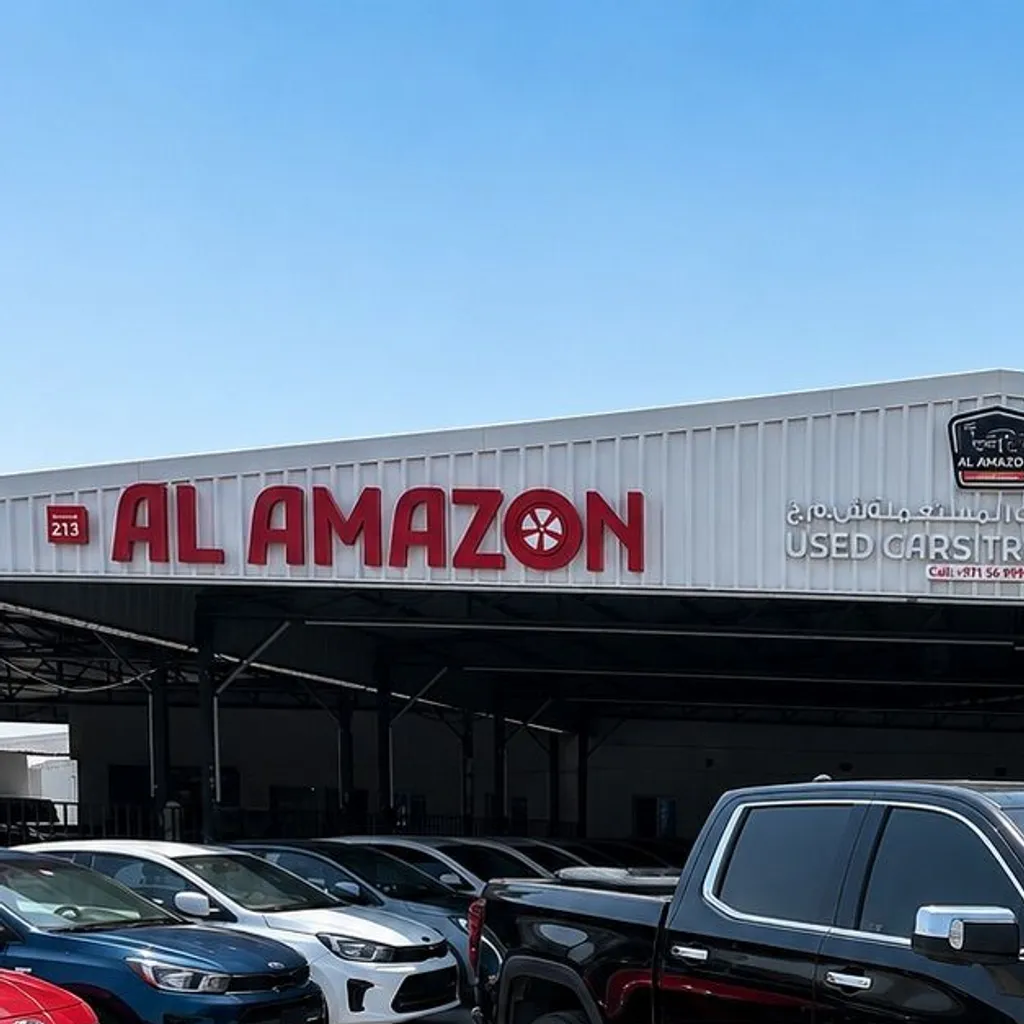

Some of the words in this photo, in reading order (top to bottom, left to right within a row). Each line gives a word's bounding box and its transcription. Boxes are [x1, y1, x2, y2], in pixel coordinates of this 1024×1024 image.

[957, 456, 974, 467] AL
[51, 522, 80, 537] 213
[111, 481, 226, 564] AL
[246, 485, 645, 573] AMAZON
[785, 532, 874, 561] USED
[883, 533, 973, 562] CARS
